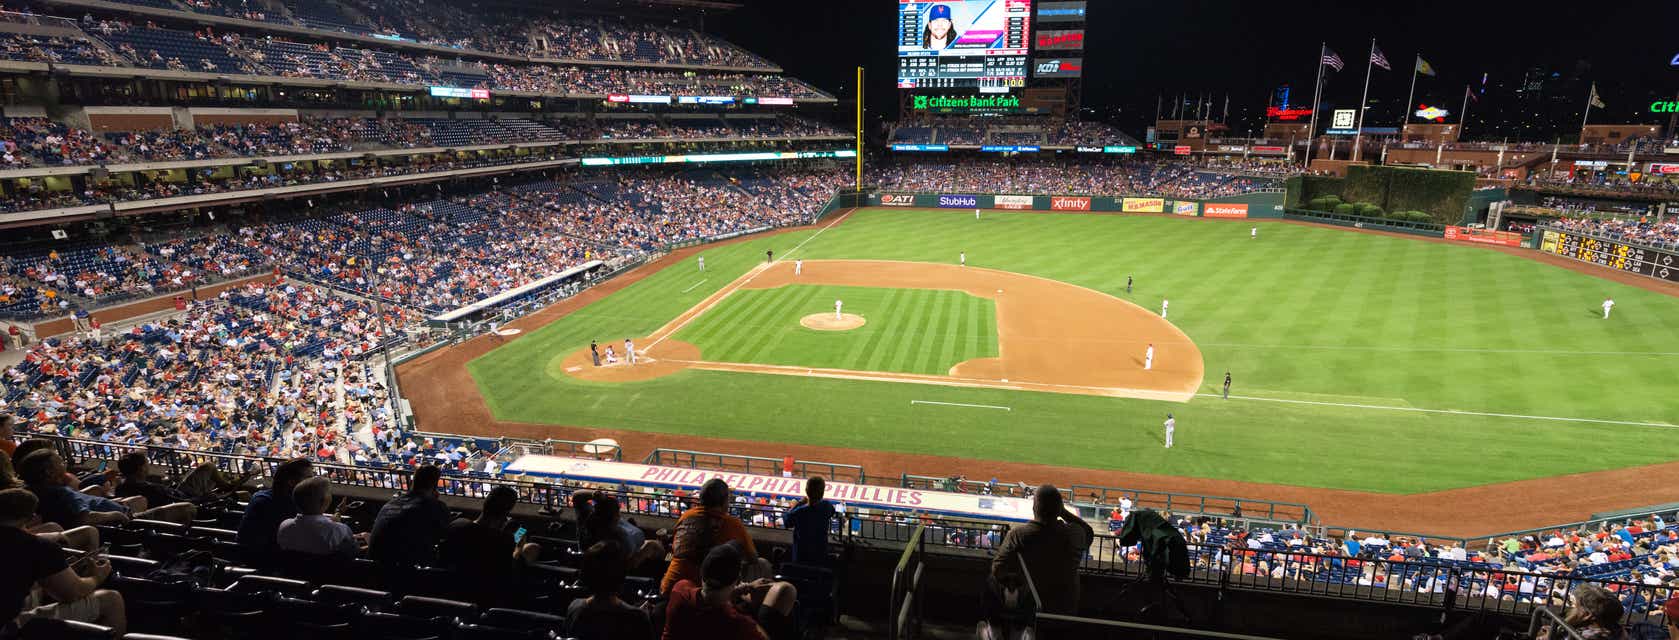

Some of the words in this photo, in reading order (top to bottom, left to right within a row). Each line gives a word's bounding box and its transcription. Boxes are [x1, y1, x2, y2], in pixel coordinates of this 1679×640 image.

[929, 97, 968, 107] Citizens
[970, 97, 995, 107] Bank
[997, 97, 1019, 107] Park
[938, 197, 976, 206] StubHub
[1054, 199, 1088, 210] xfinity
